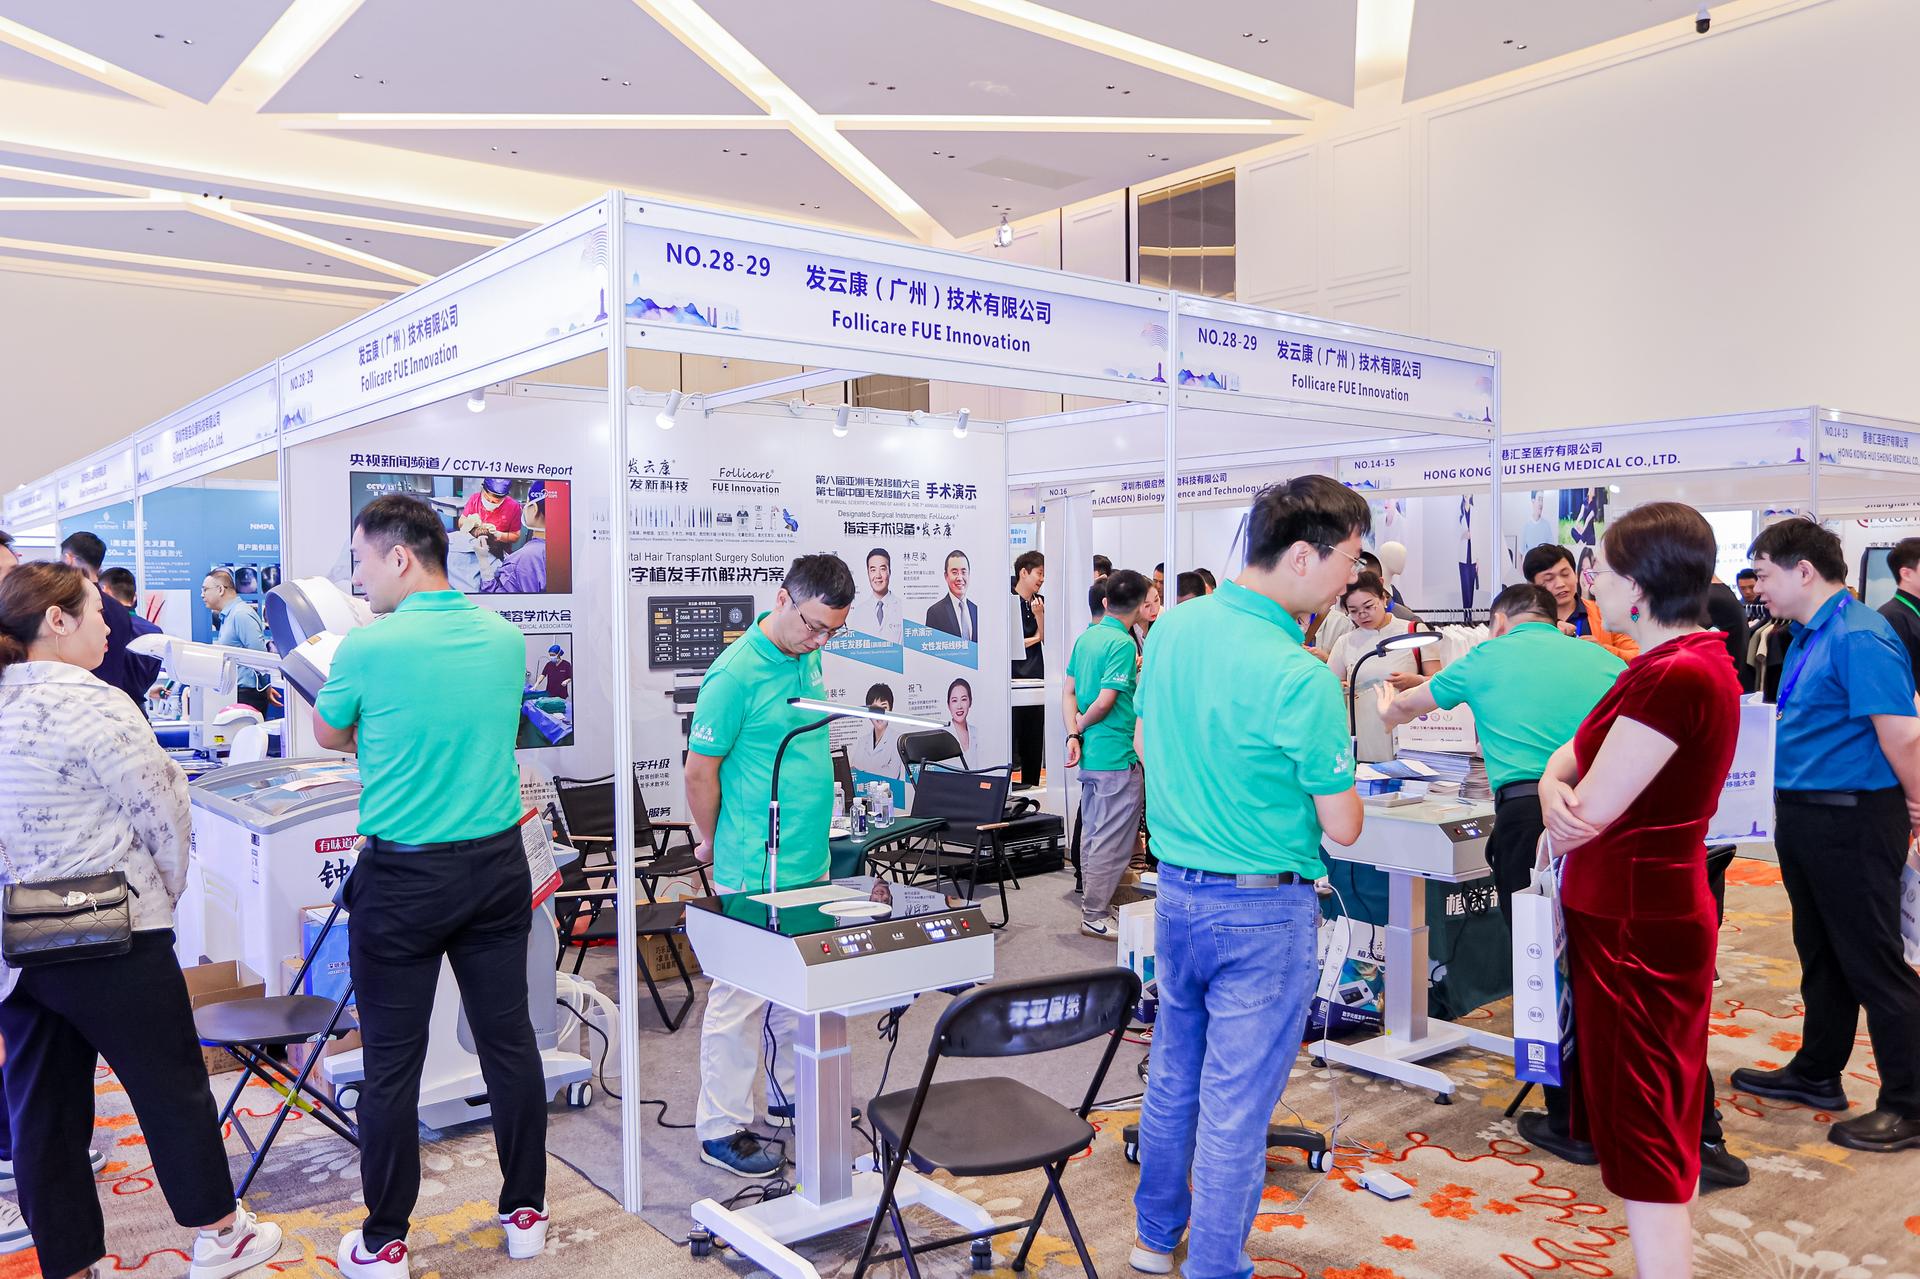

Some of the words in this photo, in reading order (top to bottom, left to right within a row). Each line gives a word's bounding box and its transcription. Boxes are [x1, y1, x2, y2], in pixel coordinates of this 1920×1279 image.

[666, 242, 771, 278] NO.28-29
[832, 309, 907, 337] Follicare
[911, 320, 942, 341] FUE
[946, 324, 1031, 353] Innovation
[1198, 327, 1257, 351] NO.28-29
[361, 370, 392, 392] Follicare
[393, 356, 408, 381] FUE
[410, 343, 458, 374] Innovation
[289, 369, 314, 391] NO.28-29
[1291, 373, 1336, 393] Follicare
[1338, 380, 1356, 395] FUE
[1358, 381, 1409, 402] Innovation
[1825, 426, 1848, 438] NO.14-15
[350, 453, 440, 470] 央视新闻频道
[453, 460, 501, 473] CCTV-13
[504, 462, 534, 474] News
[537, 463, 573, 476] Report
[1354, 458, 1396, 470] NO.14-15
[1423, 469, 1457, 481] HONG
[1459, 467, 1491, 479] KONG
[1502, 465, 1516, 475] UI
[1519, 460, 1562, 474] SHENG
[1564, 457, 1622, 472] MEDICAL
[1625, 453, 1680, 470] CO.,LTD.
[712, 482, 729, 492] FUE
[731, 482, 779, 493] Innovation
[926, 482, 977, 501] 手术演示
[1098, 494, 1136, 506] (ACMEON)
[1137, 491, 1165, 504] Biology
[1198, 487, 1212, 496] and
[1214, 484, 1261, 498] Technology
[838, 510, 871, 519] Designated
[872, 511, 894, 520] Surgical
[644, 552, 663, 561] Hair
[666, 552, 712, 563] Transplant
[715, 553, 748, 564] Surgery
[751, 553, 785, 562] Solution
[629, 566, 785, 582] 字植发手术解决方案
[646, 807, 671, 818] 服务
